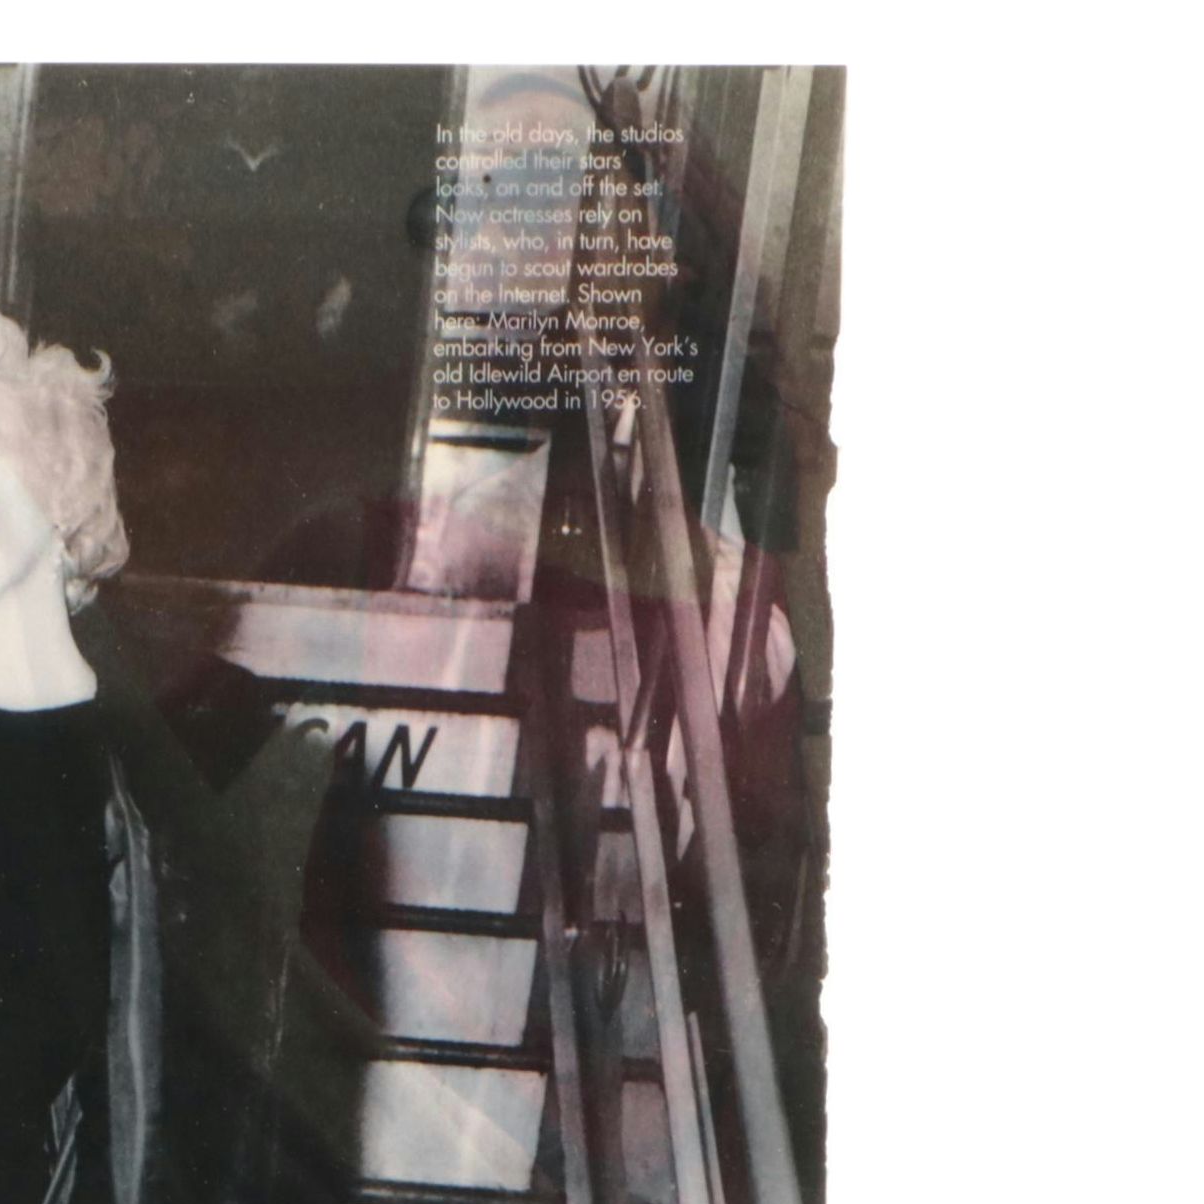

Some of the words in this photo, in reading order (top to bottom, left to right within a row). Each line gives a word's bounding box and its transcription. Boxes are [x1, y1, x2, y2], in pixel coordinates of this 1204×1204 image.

[436, 123, 453, 143] In
[459, 122, 487, 143] the
[493, 121, 523, 143] old
[529, 121, 579, 148] days,
[587, 121, 614, 143] the
[621, 121, 684, 143] studios
[435, 148, 527, 170] controlled
[534, 148, 572, 169] their
[436, 175, 488, 199] looks,
[496, 182, 519, 197] on
[526, 175, 563, 197] and
[569, 174, 595, 197] off
[599, 175, 627, 197] the
[633, 179, 664, 197] set.
[435, 204, 483, 224] Now
[490, 207, 572, 224] actresses
[579, 202, 612, 229] rely
[618, 209, 643, 224] on
[435, 231, 495, 254] stylists,
[503, 230, 549, 254] who,
[557, 232, 574, 251] in
[579, 233, 619, 253] turn,
[627, 230, 674, 251] have
[435, 256, 494, 281] begun
[500, 259, 517, 277] to
[523, 259, 571, 277] scout
[577, 257, 678, 277] wardrobes
[434, 289, 456, 304] on
[464, 283, 493, 304] the
[499, 283, 570, 304] Internet.
[578, 284, 642, 304] Shown
[487, 308, 559, 335] Marilyn
[565, 309, 645, 333] Monroe,
[433, 336, 533, 363] embarking
[540, 335, 582, 357] from
[588, 337, 635, 357] New
[433, 363, 463, 385] old
[469, 363, 541, 384] Idlewild
[547, 364, 612, 389] Airport
[617, 369, 640, 383] en
[647, 366, 694, 383] route
[433, 393, 451, 411] to
[457, 389, 558, 415] Hollywood
[565, 390, 581, 410] in
